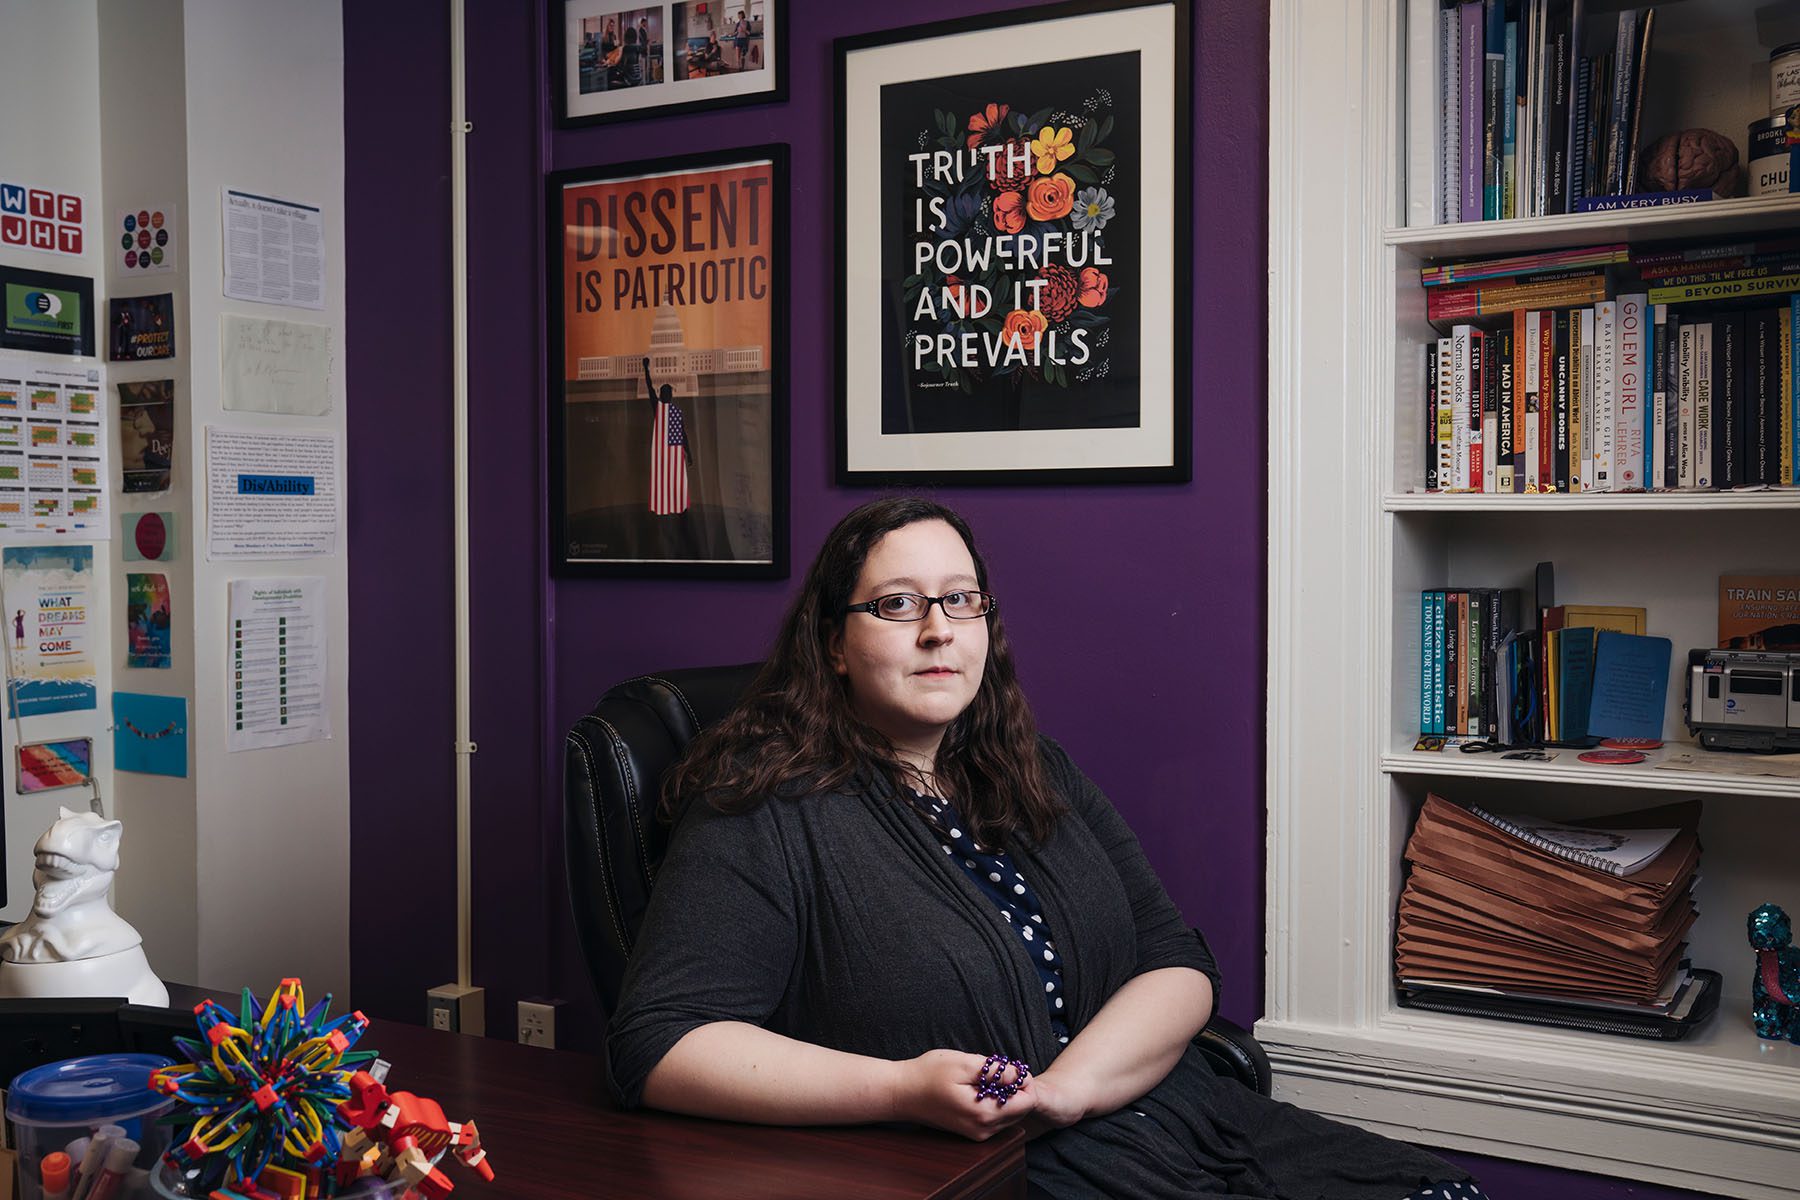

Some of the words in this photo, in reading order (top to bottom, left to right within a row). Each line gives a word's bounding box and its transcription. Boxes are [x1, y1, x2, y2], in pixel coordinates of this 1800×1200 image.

[1557, 33, 1565, 61] Supported
[909, 142, 1031, 188] TRUTH
[3, 188, 78, 219] WTF
[915, 197, 947, 232] IS
[1588, 203, 1591, 211] I
[1596, 202, 1616, 210] AM
[1621, 198, 1657, 208] VERY
[1662, 195, 1699, 205] BUSY
[576, 177, 768, 262] DISSENT
[6, 221, 80, 250] JHT
[915, 230, 1113, 275] POWERFUL
[576, 270, 601, 314] IS
[614, 255, 767, 311] PATRIOTIC
[1663, 278, 1674, 287] WE
[1676, 276, 1687, 285] DO
[1690, 274, 1706, 283] THIS
[1723, 271, 1734, 280] WE
[1737, 268, 1755, 278] FREE
[1757, 267, 1768, 276] US
[1685, 283, 1742, 298] BEYOND
[914, 284, 992, 321] AND
[1014, 280, 1048, 312] IT
[1572, 311, 1580, 347] Representing
[1623, 302, 1638, 366] GOLEM
[915, 329, 1090, 370] PREVAILS
[1456, 335, 1465, 371] Normal
[1472, 347, 1480, 370] SEND
[1604, 323, 1612, 372] RAISING
[1681, 331, 1690, 367] Disability
[1501, 364, 1511, 389] MAD
[1558, 356, 1566, 408] UNCANNY
[1656, 352, 1664, 390] Imperfection
[1680, 368, 1690, 402] Visibility
[1455, 374, 1464, 402] Sucks
[1501, 391, 1511, 403] IN
[1542, 380, 1550, 391] My
[1622, 372, 1637, 415] GIRL
[1698, 379, 1710, 402] CARE
[1501, 405, 1511, 456] AMERICA
[1698, 405, 1709, 430] WORK
[1617, 421, 1628, 466] LEHRER
[1630, 429, 1641, 457] RIVA
[1680, 459, 1688, 478] Wong
[243, 478, 310, 495] Dis/Ability
[38, 597, 72, 608] WHAT
[1727, 588, 1772, 601] TRAIN
[38, 611, 85, 623] DREAMS
[1424, 605, 1432, 623] TOO
[39, 626, 63, 637] MAY
[1424, 624, 1432, 648] SANE
[1435, 605, 1443, 658] citizen
[1447, 629, 1456, 649] Living
[1471, 620, 1479, 644] LOST
[39, 640, 72, 652] COME
[1448, 684, 1456, 697] Life
[1470, 657, 1479, 696] LACONIA
[1423, 690, 1431, 724] WORLD
[1435, 663, 1443, 724] autistic
